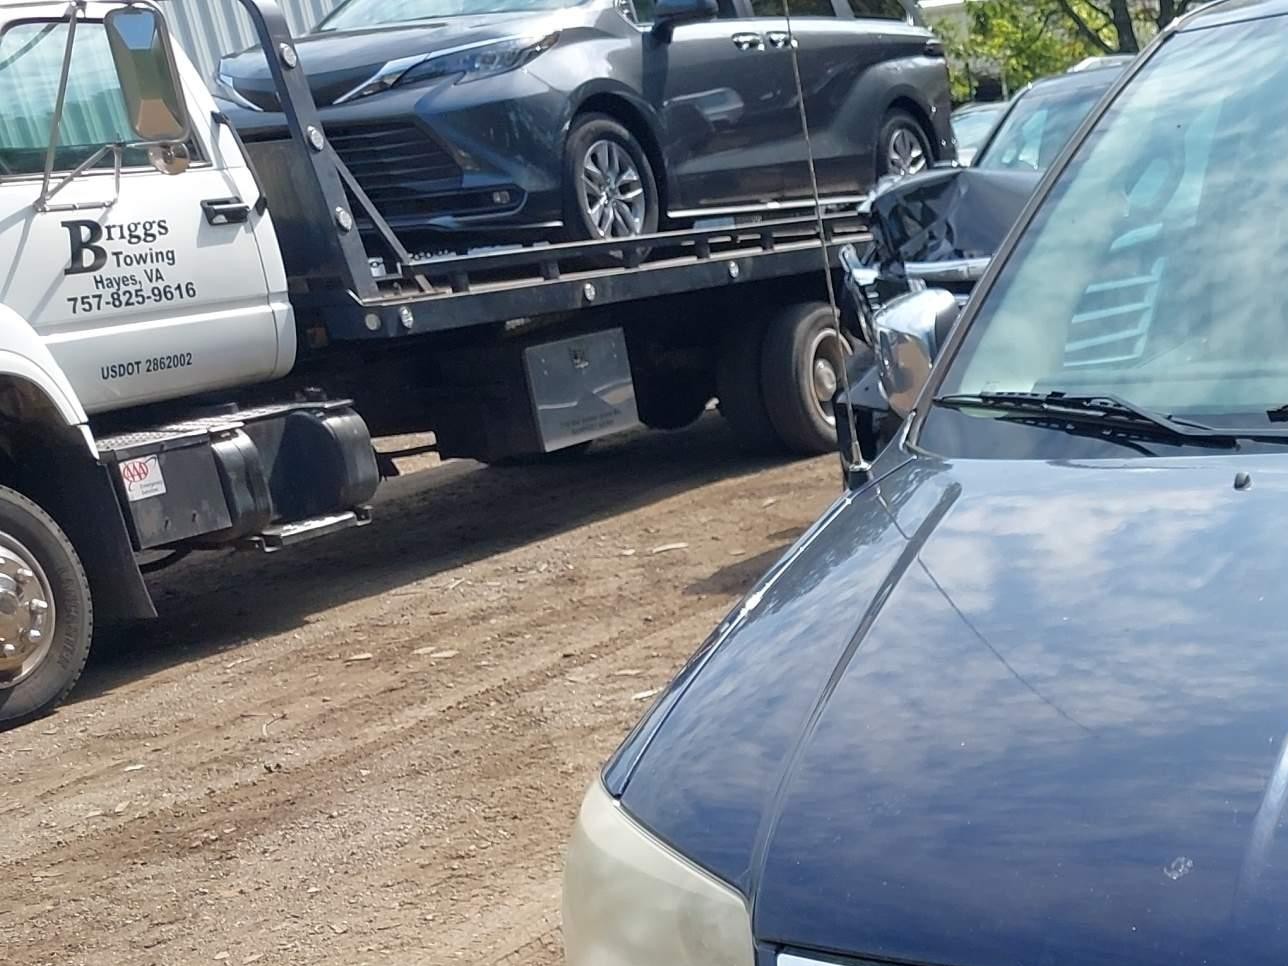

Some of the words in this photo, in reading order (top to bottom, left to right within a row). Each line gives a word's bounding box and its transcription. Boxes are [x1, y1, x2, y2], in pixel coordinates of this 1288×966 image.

[61, 219, 169, 276] Briggs
[111, 248, 176, 267] Towing
[94, 274, 143, 291] Hayes,
[144, 268, 165, 283] VA
[67, 282, 197, 314] 757-825-9616
[101, 361, 142, 380] USDOT
[145, 352, 193, 373] 2862002
